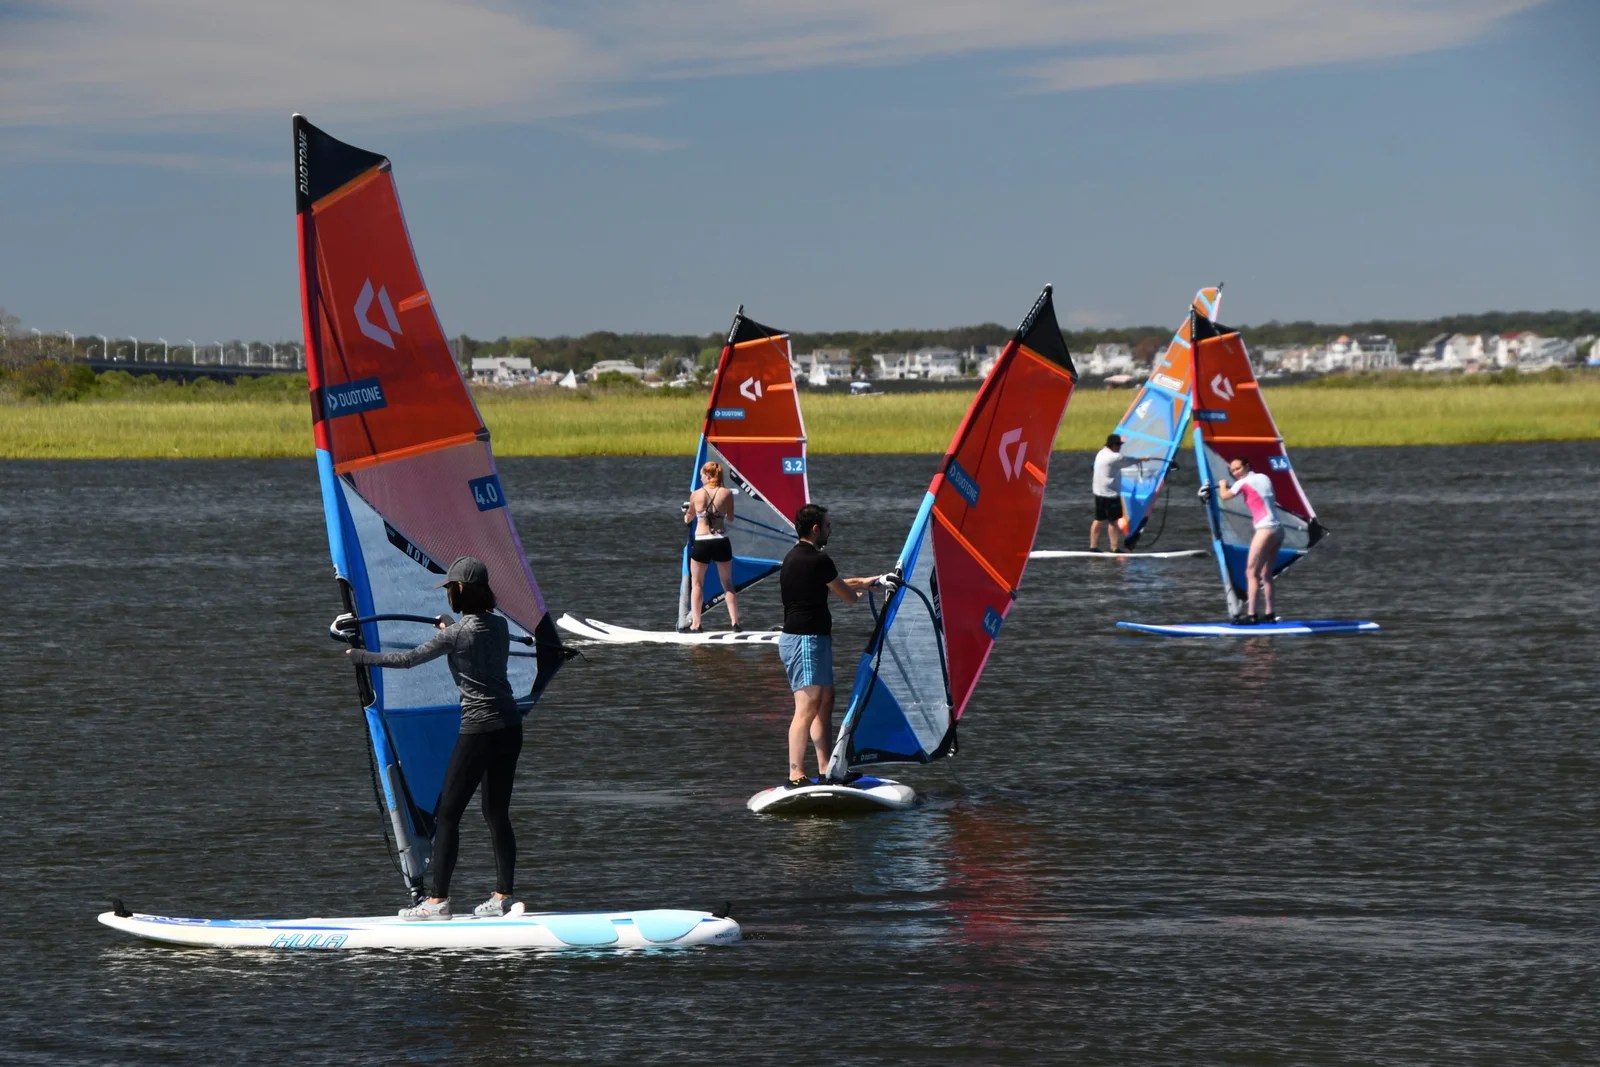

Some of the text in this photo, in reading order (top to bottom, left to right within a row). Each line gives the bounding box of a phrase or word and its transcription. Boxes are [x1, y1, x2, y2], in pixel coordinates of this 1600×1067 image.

[299, 129, 309, 195] DUOTONE
[338, 386, 382, 407] DUOTONE
[784, 460, 803, 472] 3.2
[474, 483, 498, 504] 4.0
[741, 482, 756, 497] NOW
[406, 542, 430, 568] NOW
[983, 611, 997, 634] 4.4
[269, 933, 349, 949] HULA
